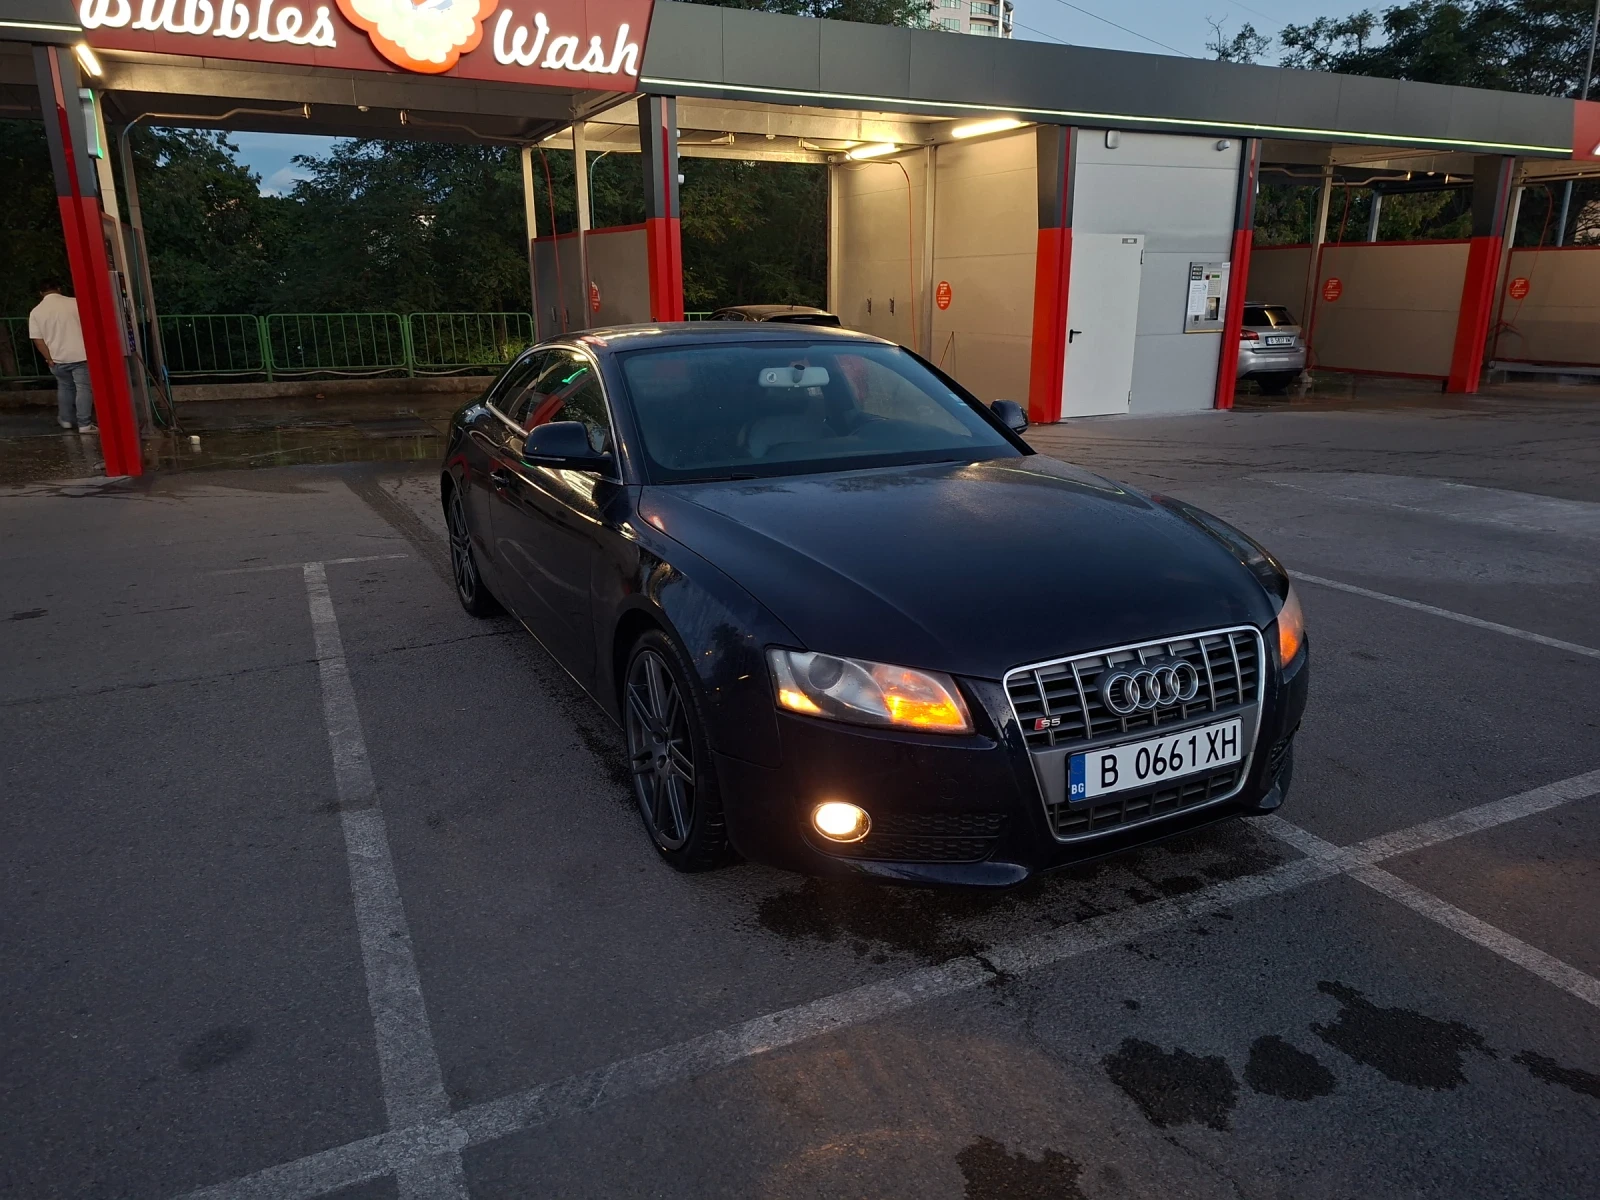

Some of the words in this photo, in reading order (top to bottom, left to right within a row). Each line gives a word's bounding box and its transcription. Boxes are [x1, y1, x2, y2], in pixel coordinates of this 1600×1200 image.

[493, 9, 639, 76] Wash
[1040, 717, 1061, 728] S5
[1100, 754, 1119, 788] B
[1135, 740, 1197, 780] 0661
[1206, 725, 1237, 763] XH
[1071, 783, 1085, 795] BG
